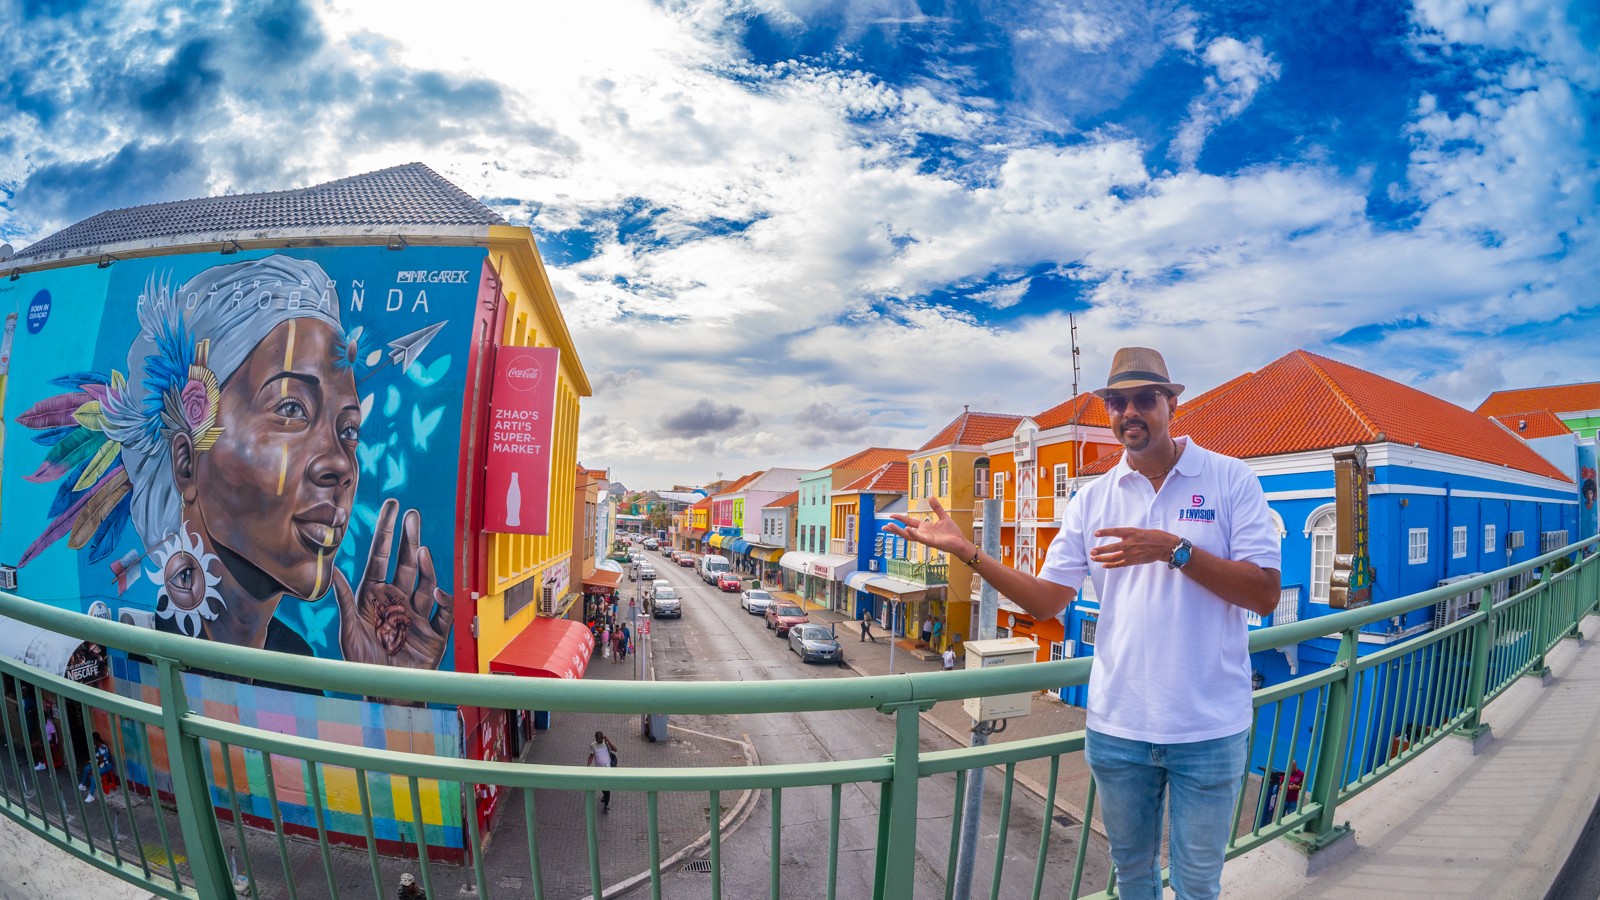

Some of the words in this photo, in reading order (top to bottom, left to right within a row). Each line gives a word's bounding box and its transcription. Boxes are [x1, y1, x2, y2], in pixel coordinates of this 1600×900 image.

[137, 294, 166, 311] PA
[495, 409, 539, 421] ZHAO'S
[494, 420, 532, 431] ARTI'S
[493, 431, 536, 443] SUPER-
[492, 443, 541, 455] MARKET
[1186, 509, 1215, 520] ENVISION
